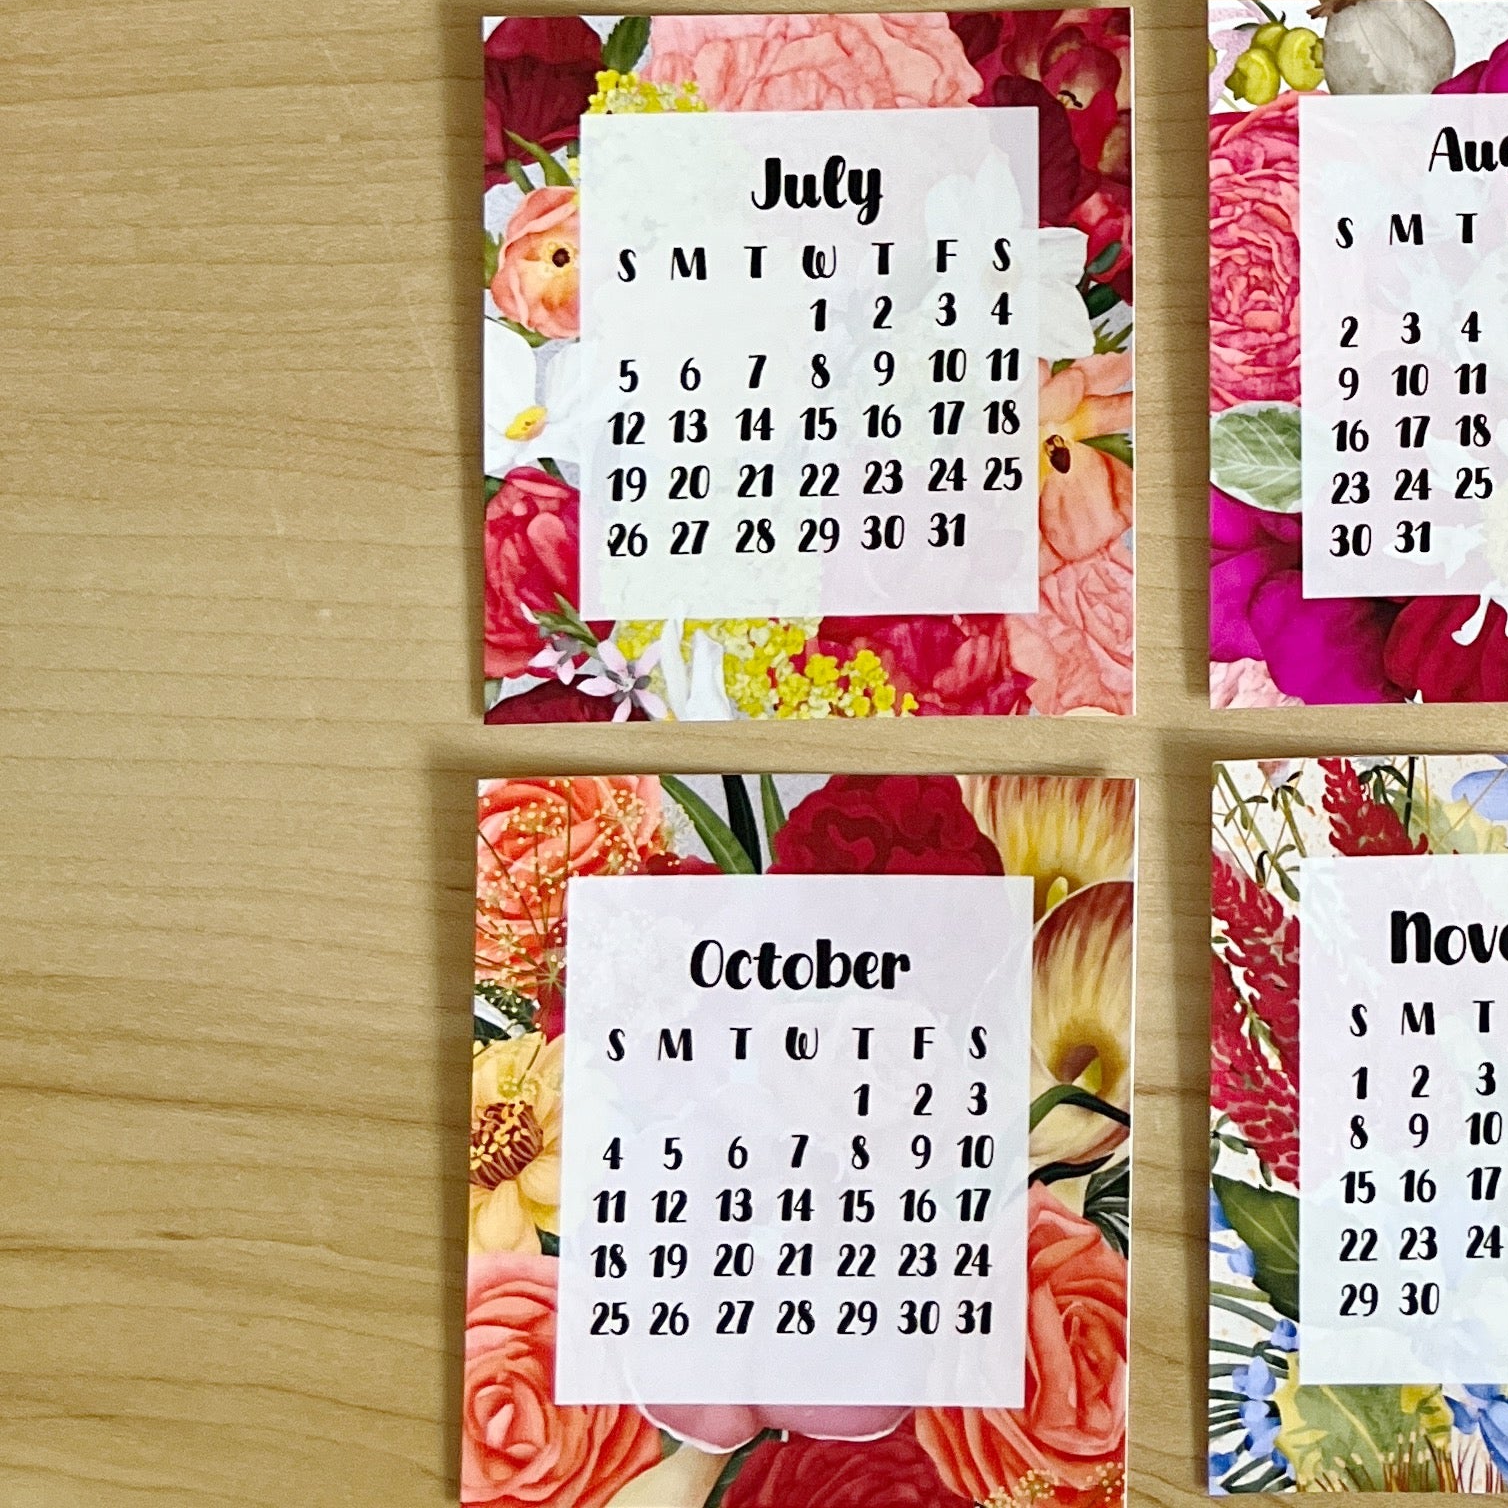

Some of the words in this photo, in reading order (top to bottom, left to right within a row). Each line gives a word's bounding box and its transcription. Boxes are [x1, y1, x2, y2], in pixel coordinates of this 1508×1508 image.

[751, 154, 884, 226] July
[1335, 217, 1354, 249] S
[1389, 213, 1424, 246] M
[1455, 212, 1478, 244] T
[617, 248, 637, 283] S
[670, 247, 707, 281] M
[743, 245, 768, 279] T
[802, 245, 837, 280] W
[871, 242, 895, 276] T
[936, 239, 959, 273] F
[992, 237, 1011, 272] S
[809, 298, 827, 332] 1
[872, 295, 893, 330] 2
[935, 292, 957, 327] 3
[990, 291, 1013, 326] 4
[1329, 523, 1372, 558] 30
[1394, 520, 1431, 554] 31
[690, 938, 911, 991] October
[1349, 1003, 1368, 1038] S
[1401, 1001, 1436, 1036] M
[1472, 1000, 1495, 1034] T
[606, 1028, 626, 1062] S
[657, 1028, 694, 1062] M
[729, 1027, 753, 1060] T
[785, 1026, 819, 1061] W
[851, 1027, 875, 1060] T
[913, 1026, 936, 1060] F
[968, 1025, 988, 1060] S
[592, 1190, 627, 1224] 11
[651, 1189, 688, 1224] 12
[715, 1187, 753, 1223] 13
[776, 1188, 815, 1222] 14
[838, 1189, 875, 1223] 15
[899, 1188, 937, 1223] 16
[955, 1188, 992, 1222] 17
[1339, 1282, 1379, 1317] 29
[1399, 1282, 1440, 1316] 30
